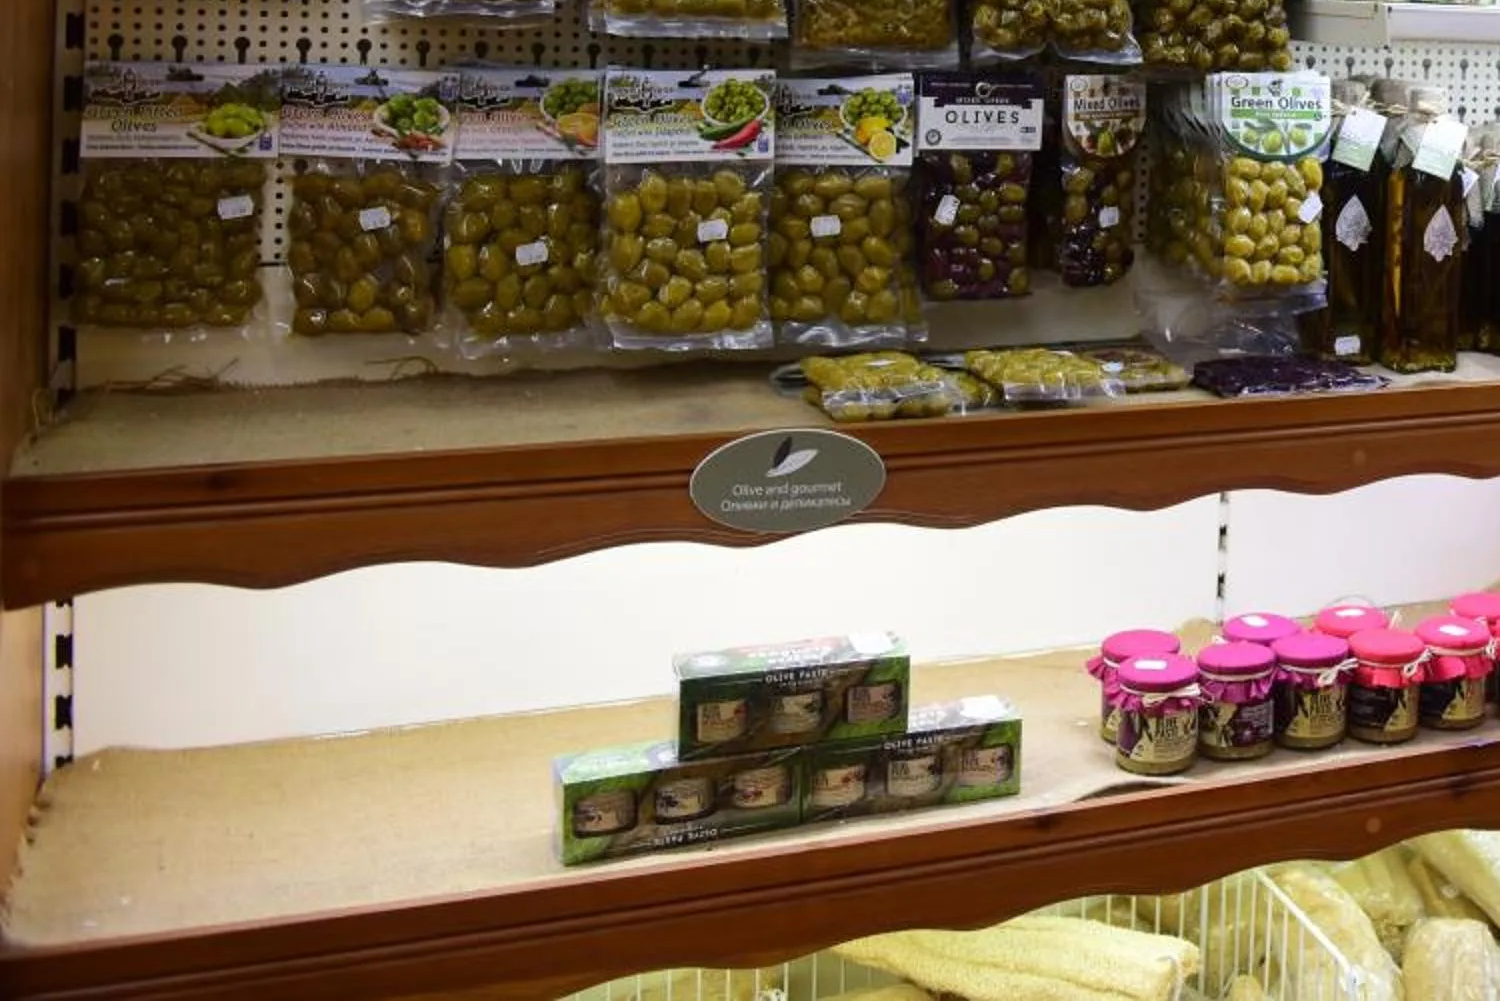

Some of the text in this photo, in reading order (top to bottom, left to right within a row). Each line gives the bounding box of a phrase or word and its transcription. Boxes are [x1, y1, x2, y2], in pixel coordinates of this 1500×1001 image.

[1073, 98, 1105, 111] Mixed
[1231, 95, 1322, 110] Green Olives
[945, 110, 1020, 124] OLIVES
[732, 481, 843, 497] Olive and gourmet
[765, 669, 827, 684] OLIVE PASTE
[883, 737, 944, 751] OLIVE PASTE
